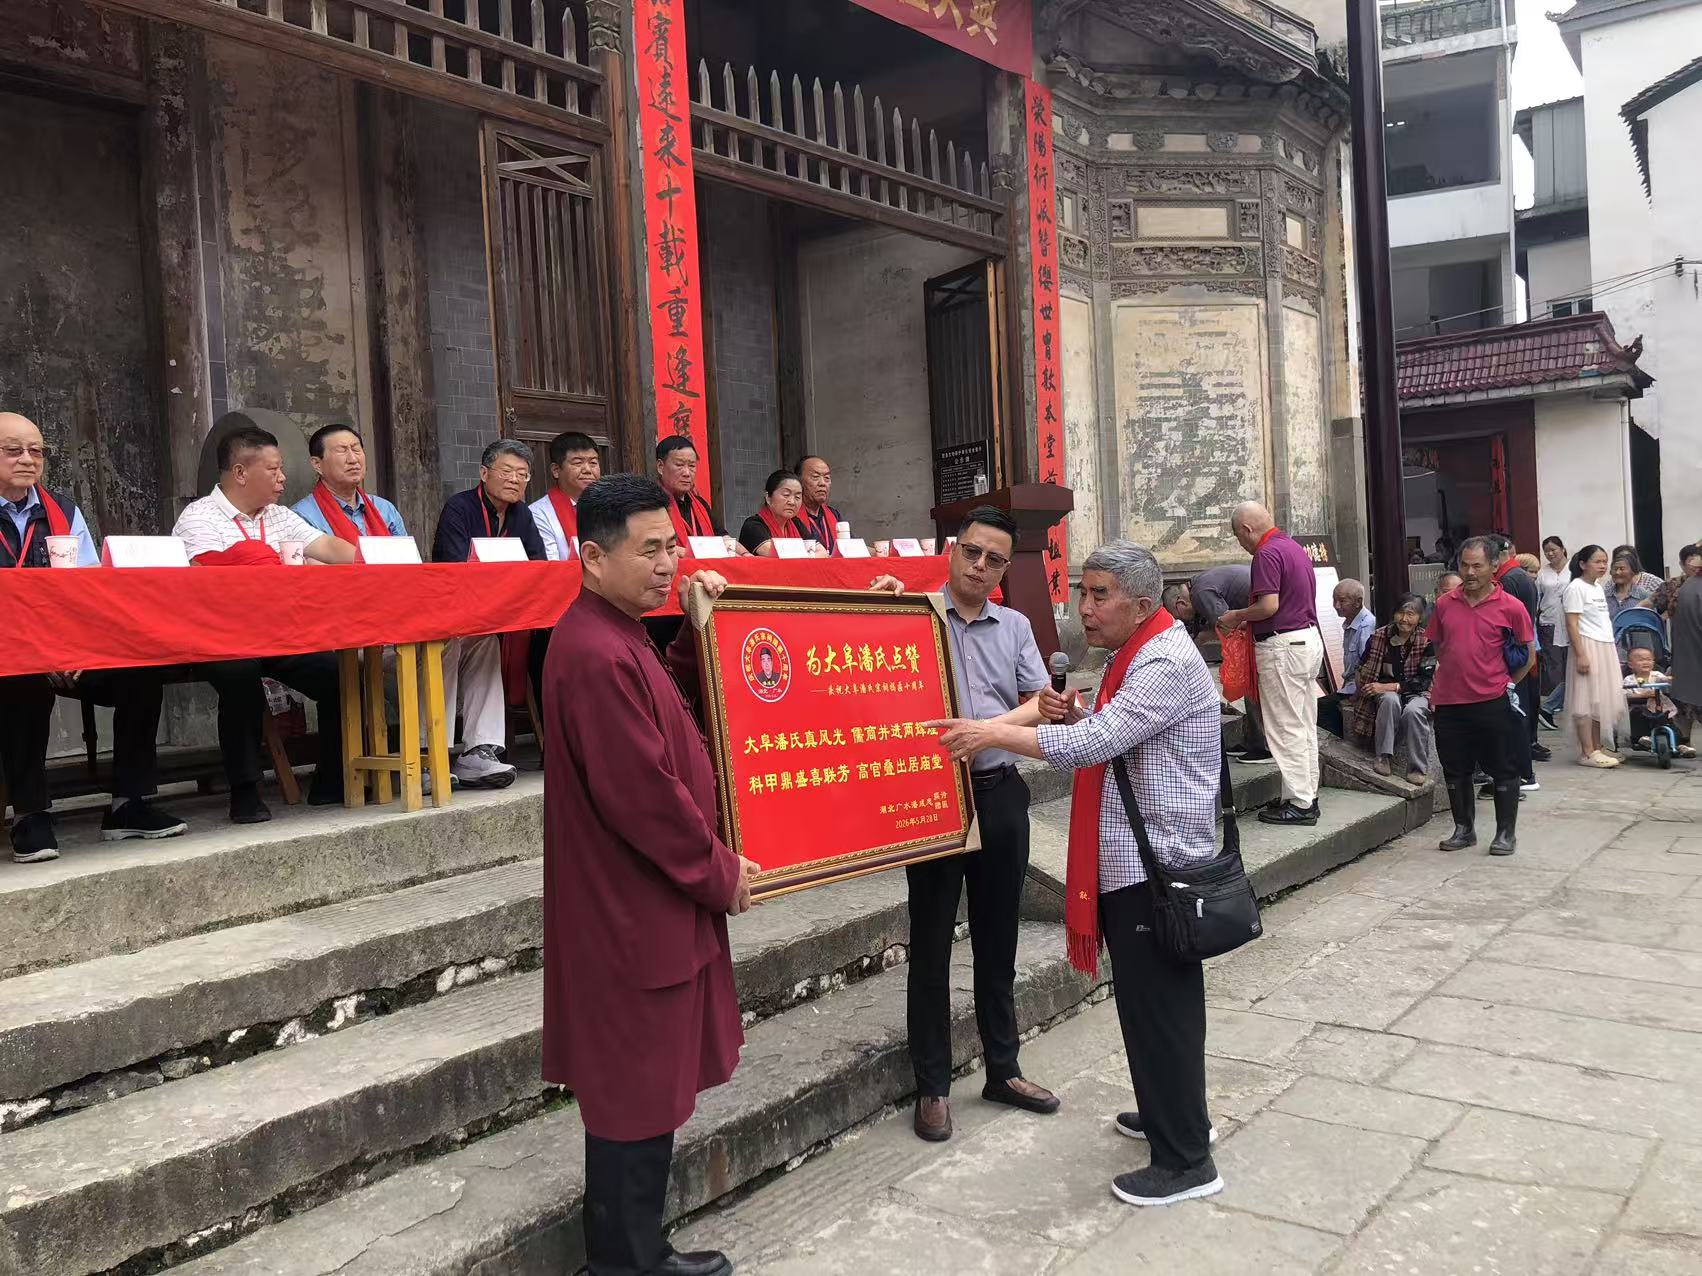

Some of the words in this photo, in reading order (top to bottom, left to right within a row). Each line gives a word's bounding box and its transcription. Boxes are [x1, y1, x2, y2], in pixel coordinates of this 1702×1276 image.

[743, 728, 846, 755] 大阜潘氏真风光
[749, 764, 850, 796] 科甲鼎盛喜联芳
[856, 753, 944, 780] 高官叠出居庙堂
